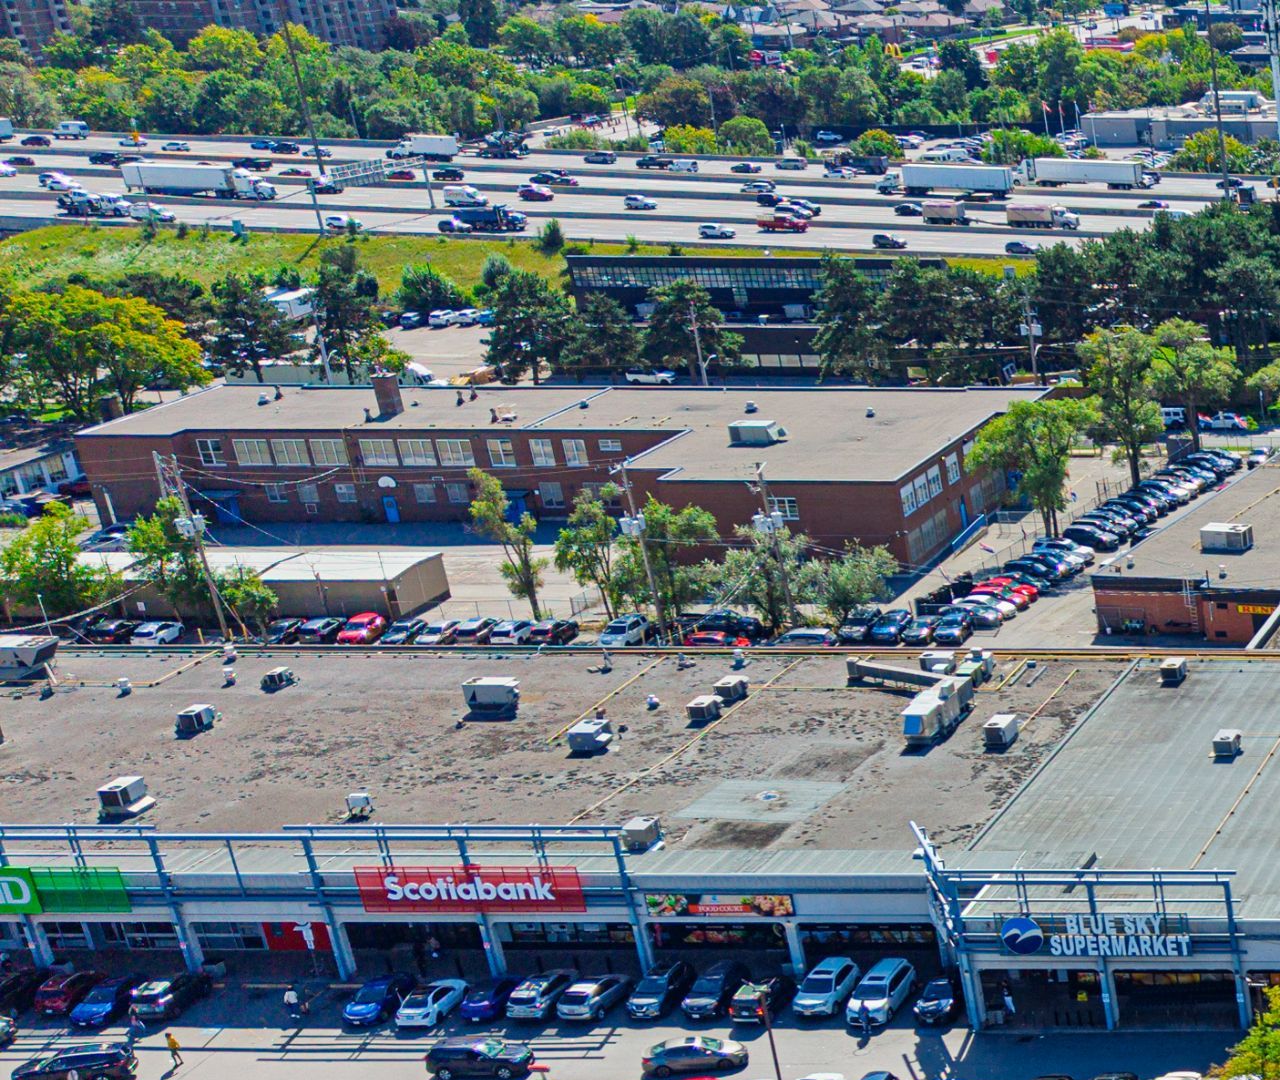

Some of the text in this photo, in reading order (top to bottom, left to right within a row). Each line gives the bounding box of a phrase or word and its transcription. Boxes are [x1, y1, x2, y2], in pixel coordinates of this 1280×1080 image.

[383, 875, 556, 901] Scotiabank
[1064, 913, 1163, 936] BLUE SKY
[1049, 934, 1190, 957] SUPERMARKET
